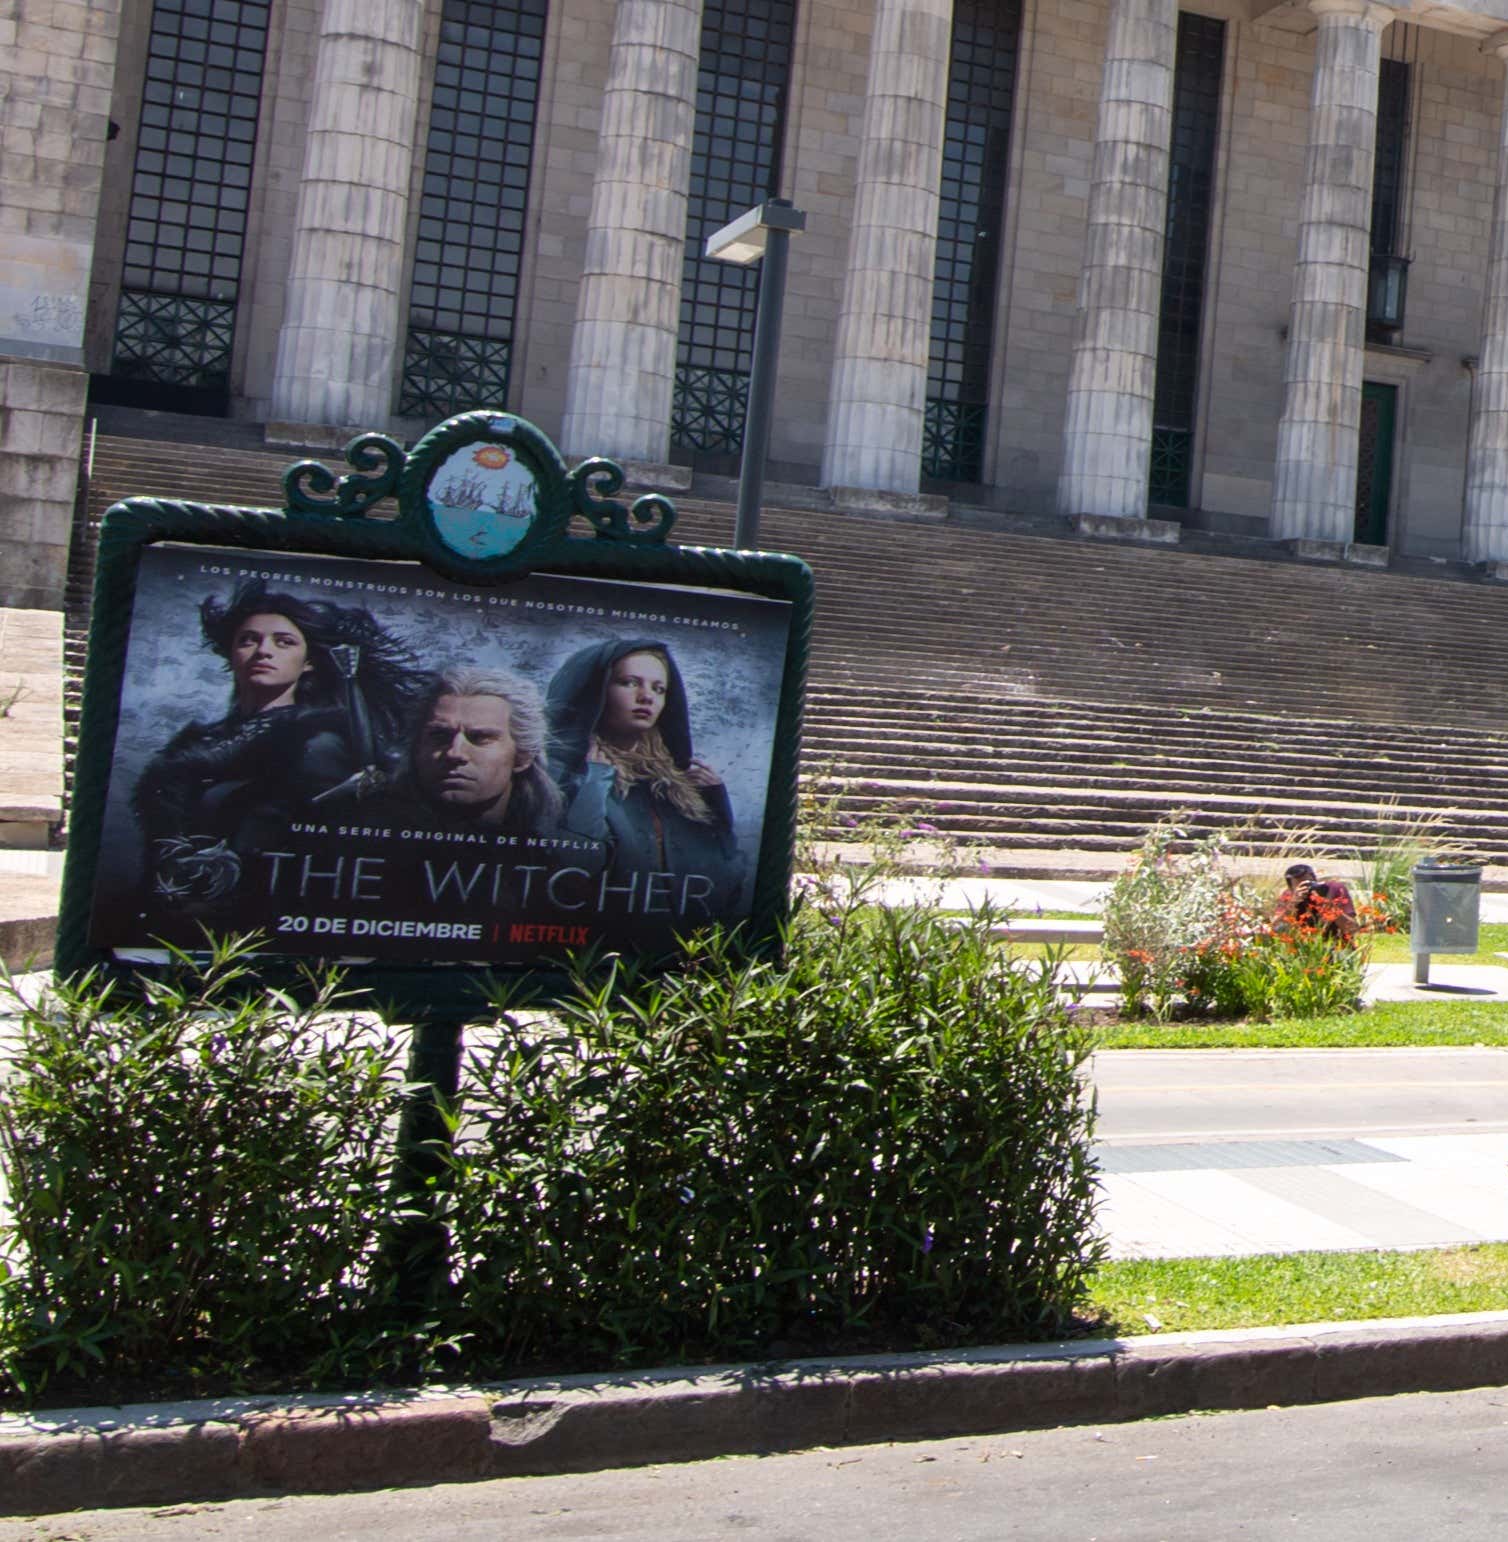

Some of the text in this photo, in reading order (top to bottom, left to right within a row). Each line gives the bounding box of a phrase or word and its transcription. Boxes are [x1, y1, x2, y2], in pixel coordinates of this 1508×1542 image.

[200, 565, 740, 631] LOS PEORES MONSTRUOS SON LOS QUE NOSOTROS MISMOS CREAMOS
[291, 823, 600, 851] UNA SERIE ORIGINAL DE NETFLIX
[262, 851, 716, 917] THE WITCHER
[277, 915, 591, 945] 20 DE DICIEMBRE NETFLIX
